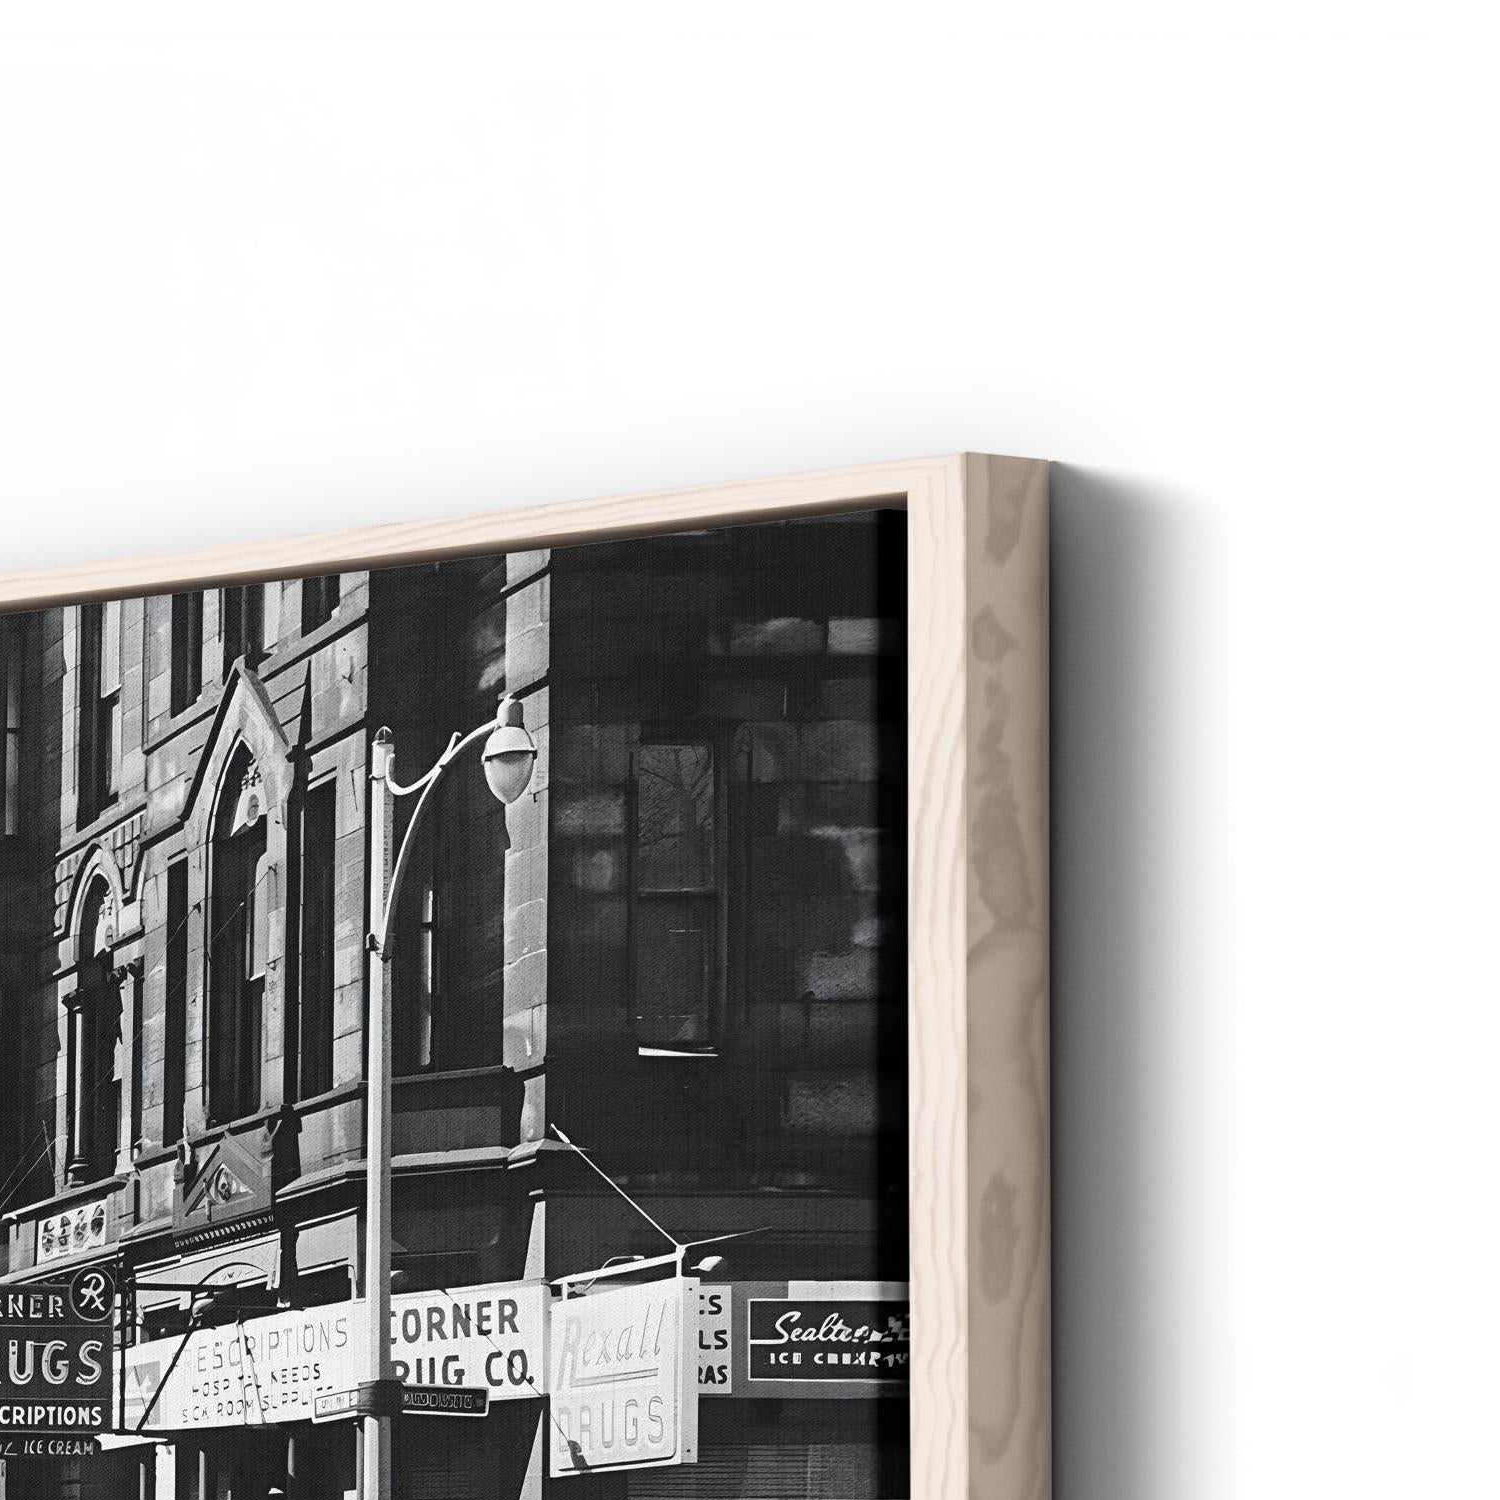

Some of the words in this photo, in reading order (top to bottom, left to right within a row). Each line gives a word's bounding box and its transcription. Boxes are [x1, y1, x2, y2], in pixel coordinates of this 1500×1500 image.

[180, 1317, 349, 1374] ESCRIPTIONS
[390, 1353, 467, 1386] RUG
[555, 1298, 668, 1392] Rexall
[23, 1439, 44, 1455] ICE
[47, 1440, 95, 1456] CREAM
[557, 1395, 665, 1453] DRUGS
